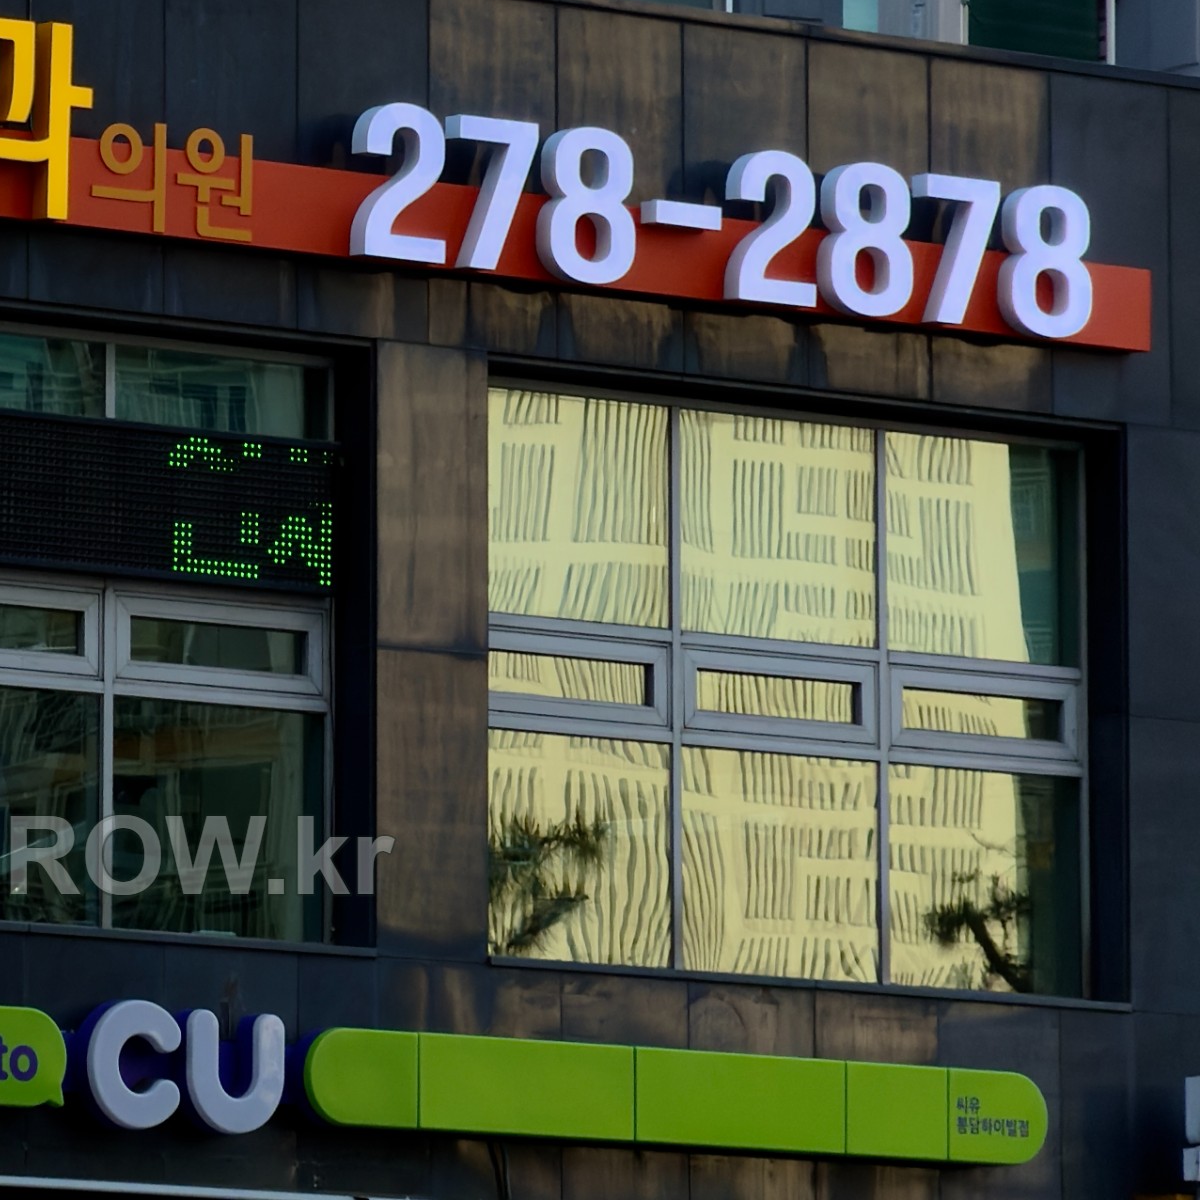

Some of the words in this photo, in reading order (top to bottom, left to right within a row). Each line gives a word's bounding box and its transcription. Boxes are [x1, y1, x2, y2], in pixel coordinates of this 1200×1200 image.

[349, 101, 1093, 339] 278-2878
[82, 999, 286, 1135] CU
[956, 1096, 980, 1115] 씨유
